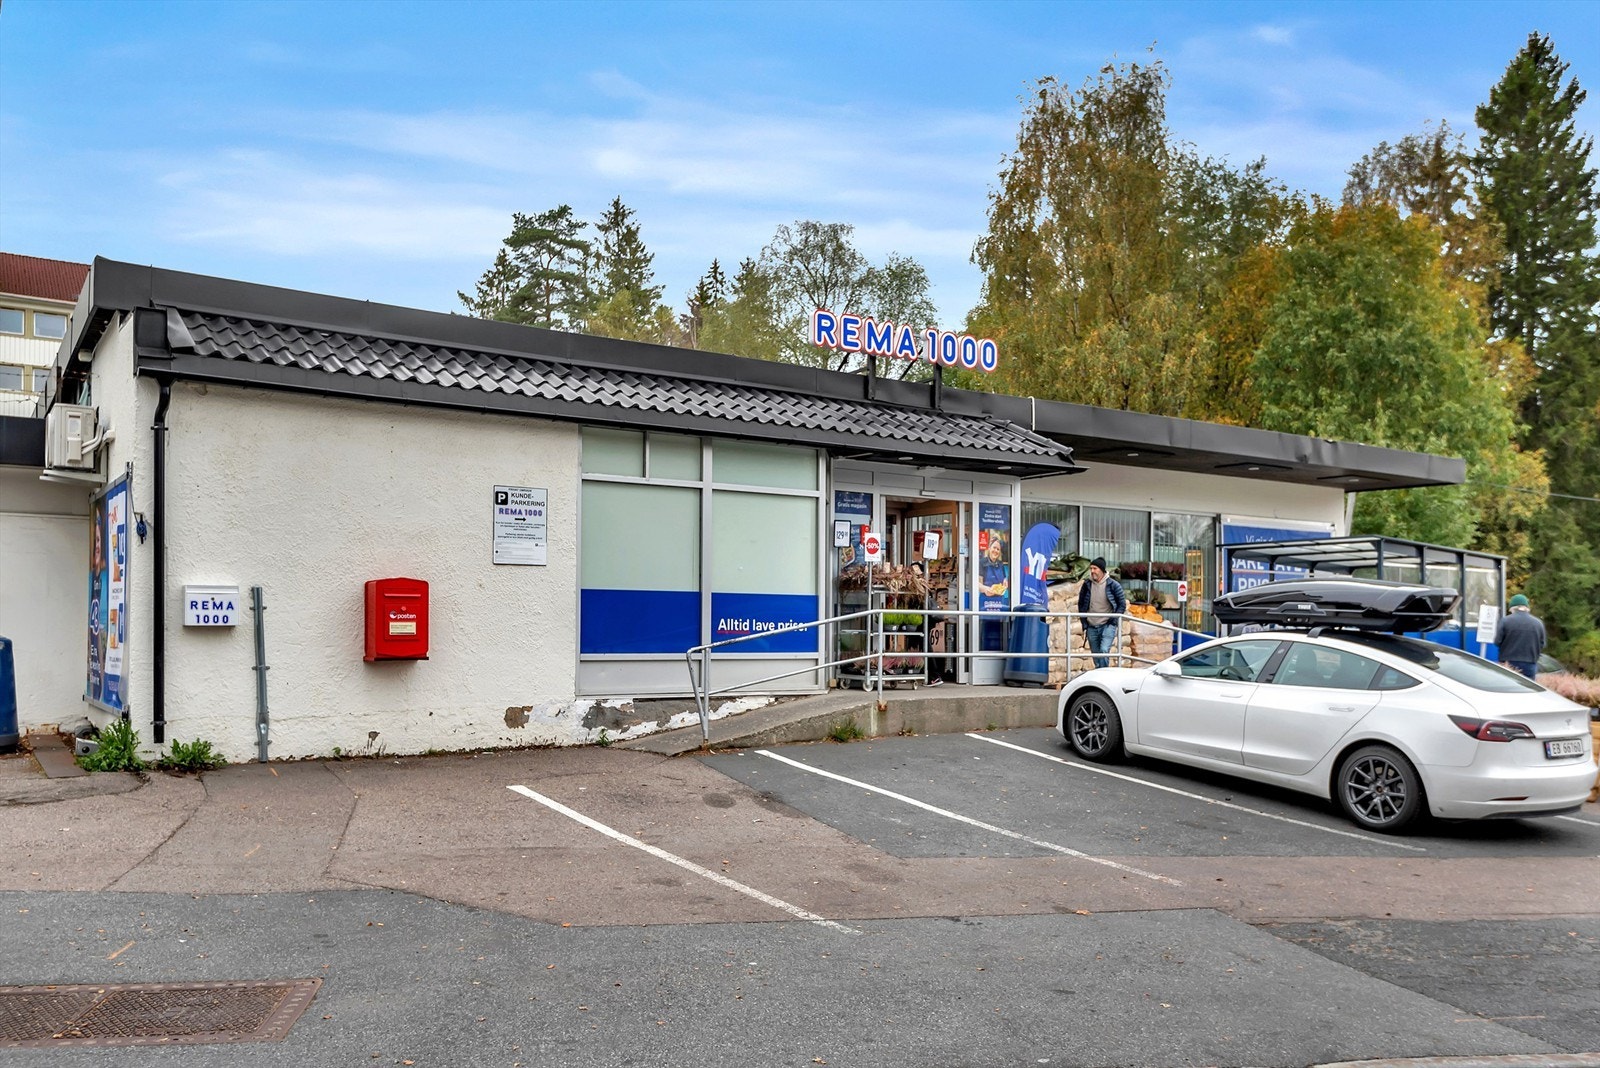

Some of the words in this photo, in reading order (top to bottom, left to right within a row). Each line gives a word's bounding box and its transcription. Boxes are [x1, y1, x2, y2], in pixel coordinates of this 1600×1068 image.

[814, 310, 918, 361] REMA
[926, 328, 998, 372] 1000
[190, 600, 234, 610] REMA
[195, 614, 229, 624] 1000
[718, 618, 750, 631] Alltid
[752, 619, 775, 632] lave
